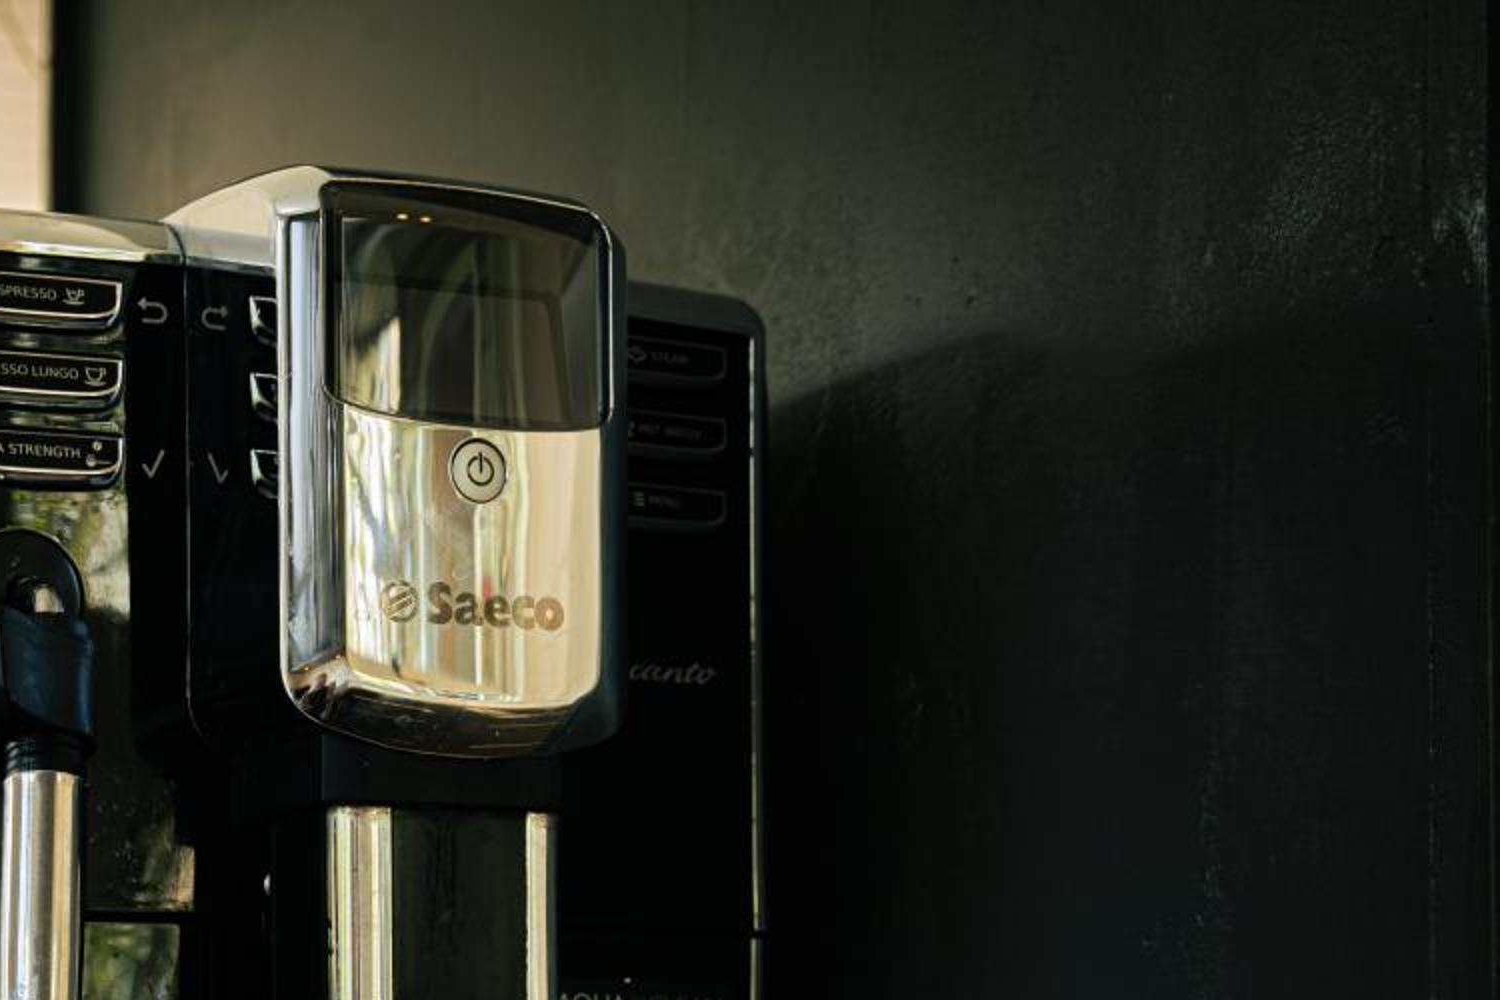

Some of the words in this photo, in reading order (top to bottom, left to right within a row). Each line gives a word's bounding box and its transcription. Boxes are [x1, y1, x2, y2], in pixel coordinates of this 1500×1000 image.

[31, 363, 79, 380] LUNGO
[8, 442, 82, 459] STRENGTH
[428, 581, 565, 632] Saeco
